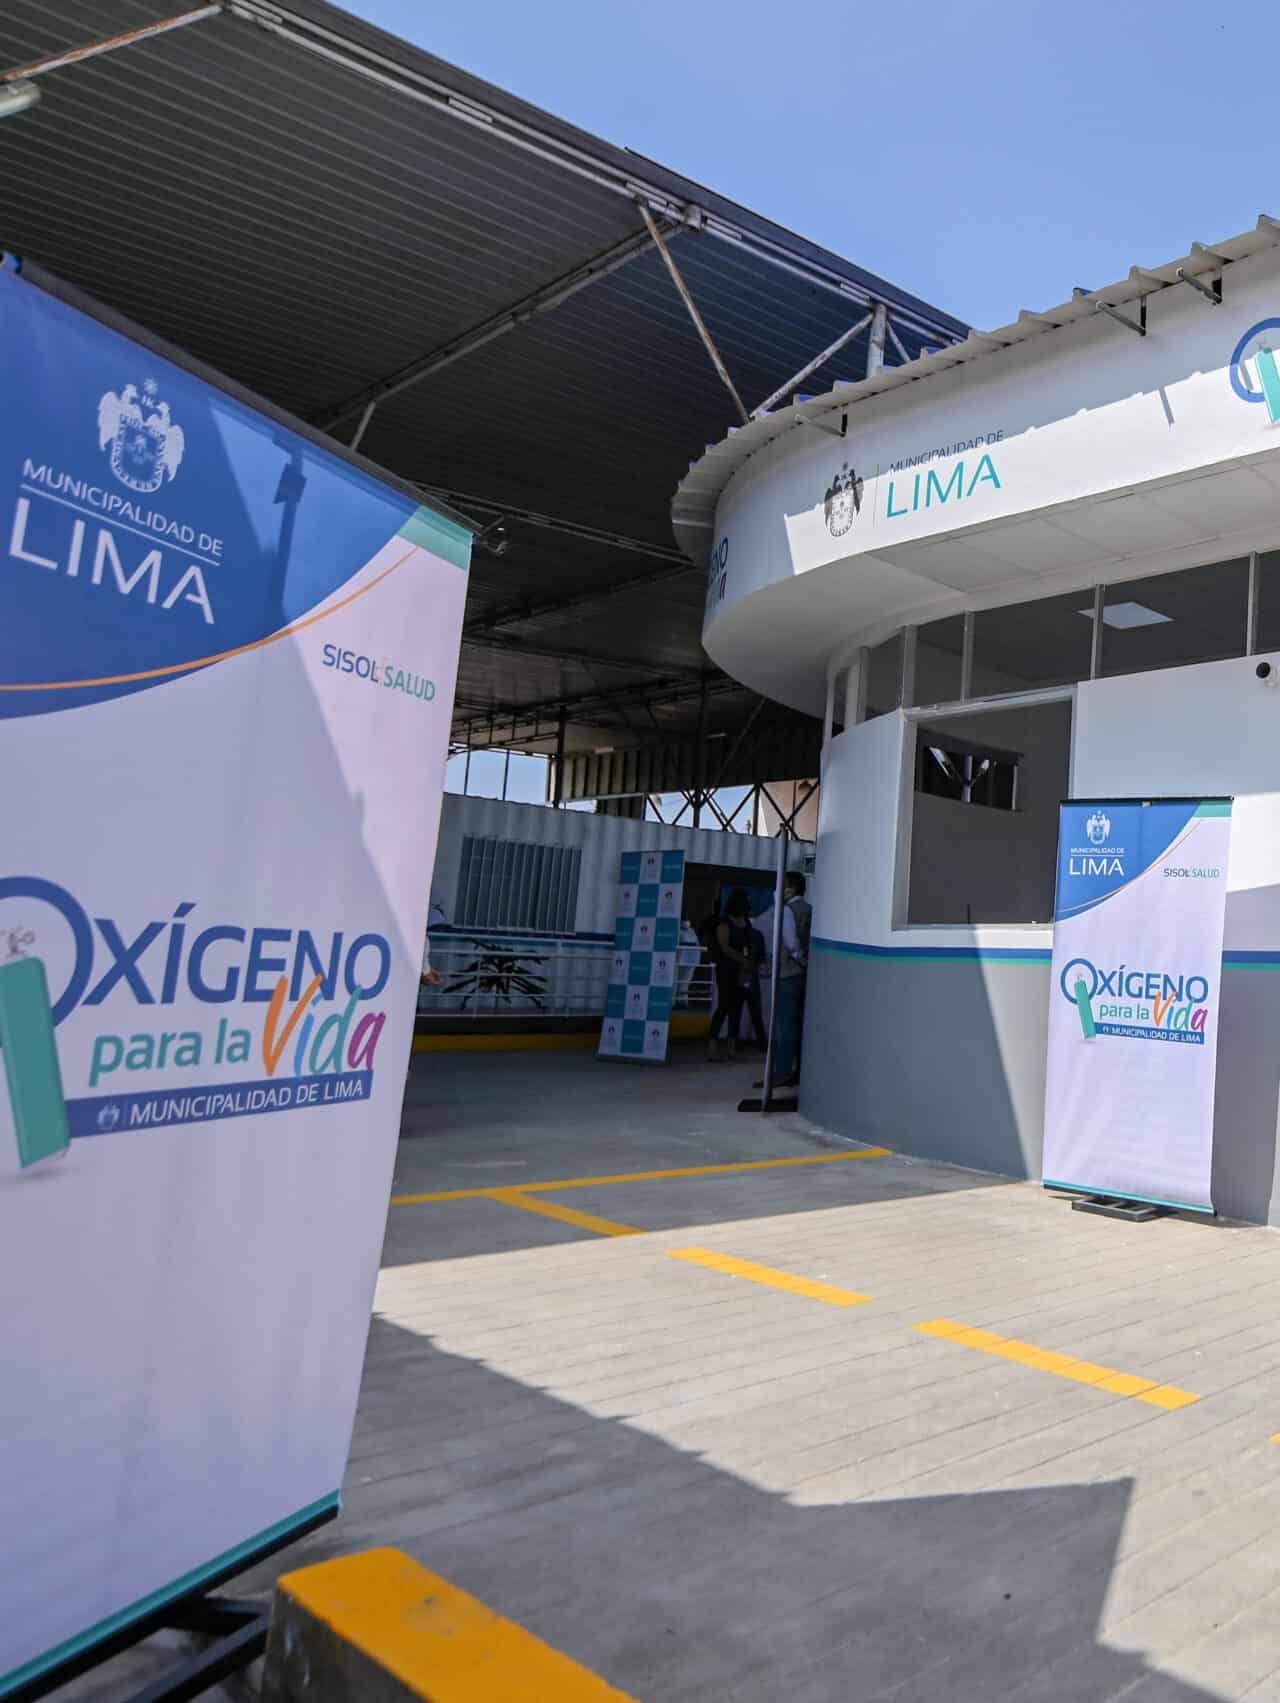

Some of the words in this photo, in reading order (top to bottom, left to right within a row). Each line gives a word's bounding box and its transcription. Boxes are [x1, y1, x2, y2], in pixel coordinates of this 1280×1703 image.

[23, 458, 194, 546] MUNICIPALIDAD
[199, 533, 224, 557] DE
[887, 454, 1001, 518] LIMA
[8, 498, 215, 625] LIMA
[322, 644, 379, 683] SISOL
[383, 665, 436, 702] SALUD
[1069, 858, 1125, 876] LIMA
[1163, 868, 1190, 877] SISOL
[1191, 868, 1220, 878] SALUD
[1060, 958, 1209, 1005] OXÍGENO
[88, 1031, 203, 1088] para
[214, 1018, 251, 1065] la
[262, 976, 387, 1080] Vida
[1099, 1003, 1132, 1020] para
[1136, 1003, 1149, 1020] la
[1153, 991, 1208, 1032] Vida
[1111, 1026, 1167, 1039] MUNICIPALIDAD
[1168, 1031, 1180, 1041] DE
[1181, 1033, 1201, 1043] LIMA
[130, 1085, 293, 1126] MUNICIPALIDAD
[296, 1083, 321, 1105] DE
[324, 1079, 364, 1101] LIMA
